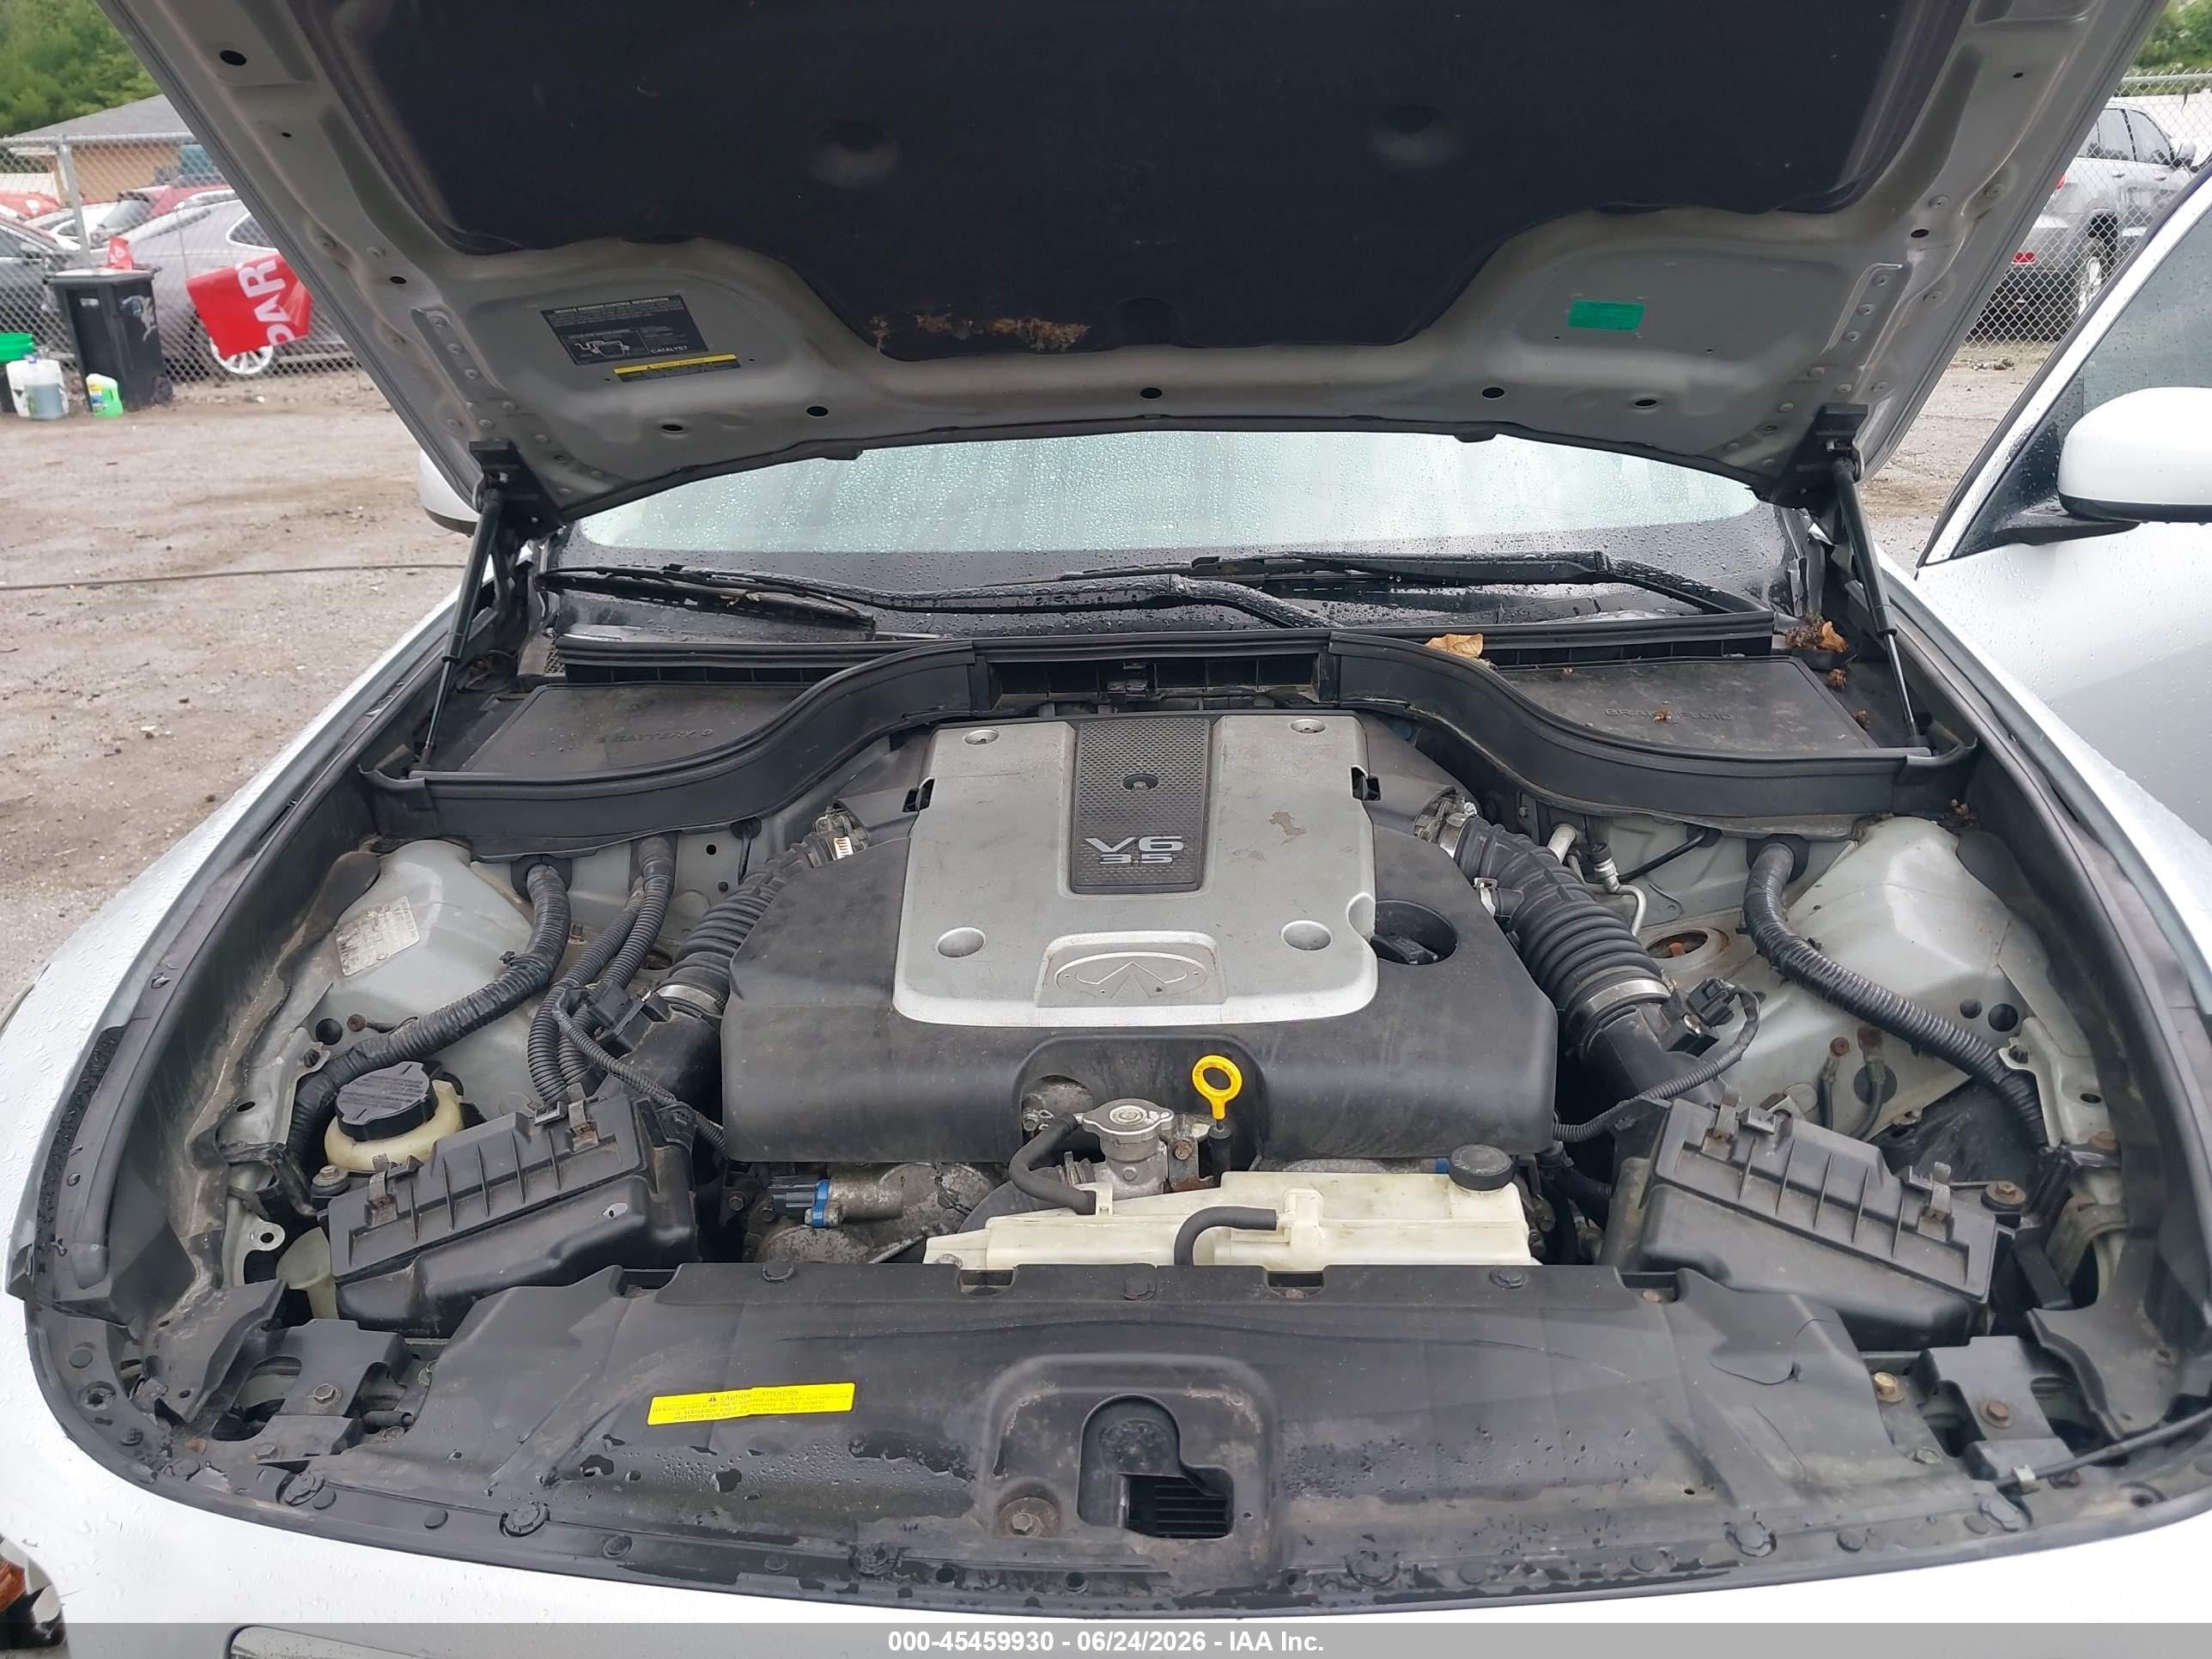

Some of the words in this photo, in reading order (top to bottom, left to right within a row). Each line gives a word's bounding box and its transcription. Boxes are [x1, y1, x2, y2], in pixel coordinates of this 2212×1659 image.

[1604, 708, 1664, 720] BRAK
[1084, 836, 1185, 853] V6
[1099, 853, 1175, 865] 3.5
[720, 1393, 750, 1402] CAUTION
[761, 1389, 799, 1398] ATTENTION
